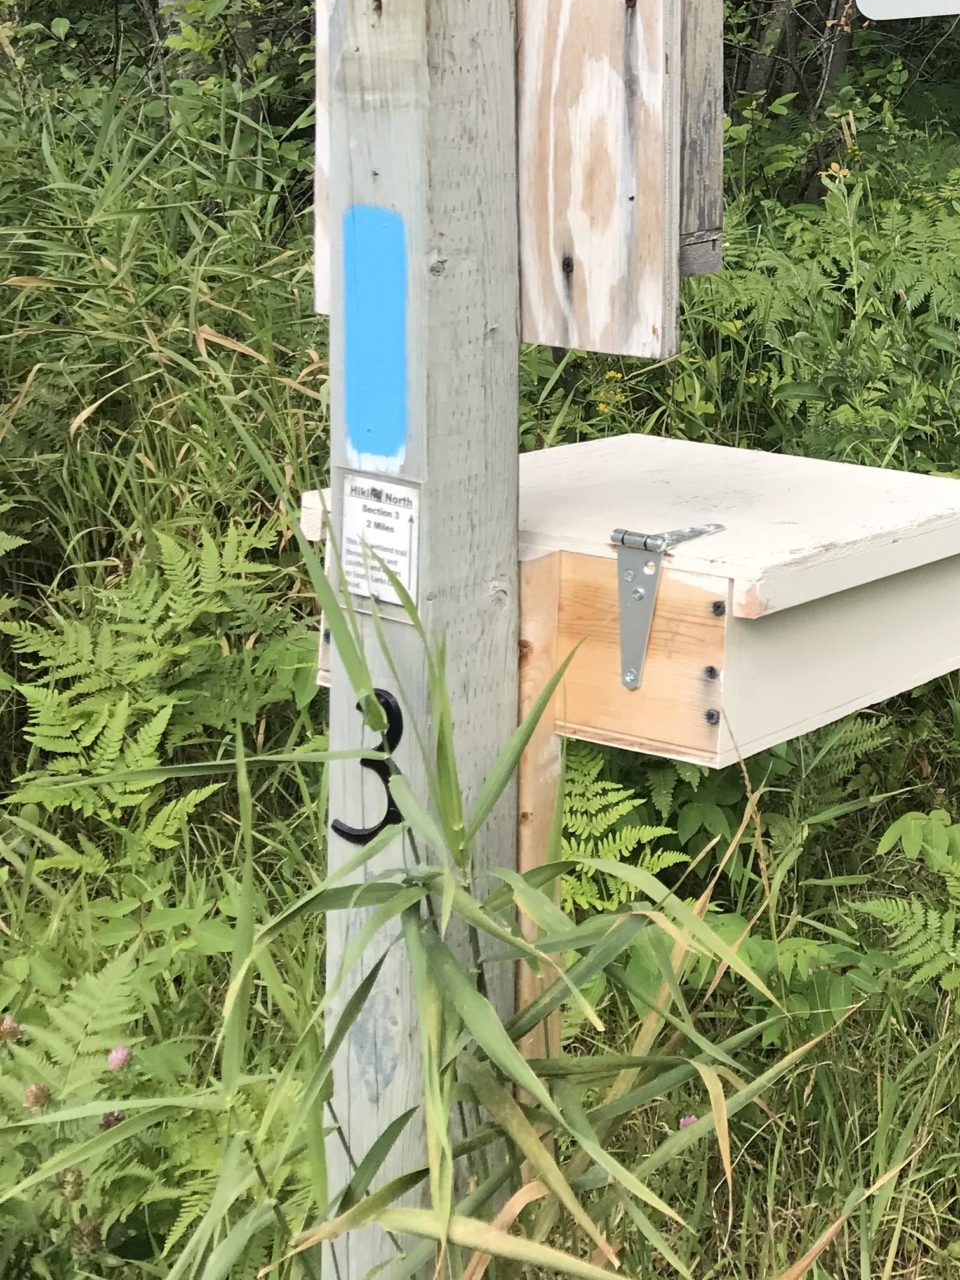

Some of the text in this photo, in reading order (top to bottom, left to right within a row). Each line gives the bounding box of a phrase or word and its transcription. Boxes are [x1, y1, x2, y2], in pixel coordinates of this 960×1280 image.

[350, 485, 413, 508] Hiki North
[361, 504, 393, 518] Section
[366, 520, 395, 533] 2 Miles
[331, 687, 404, 846] 3
